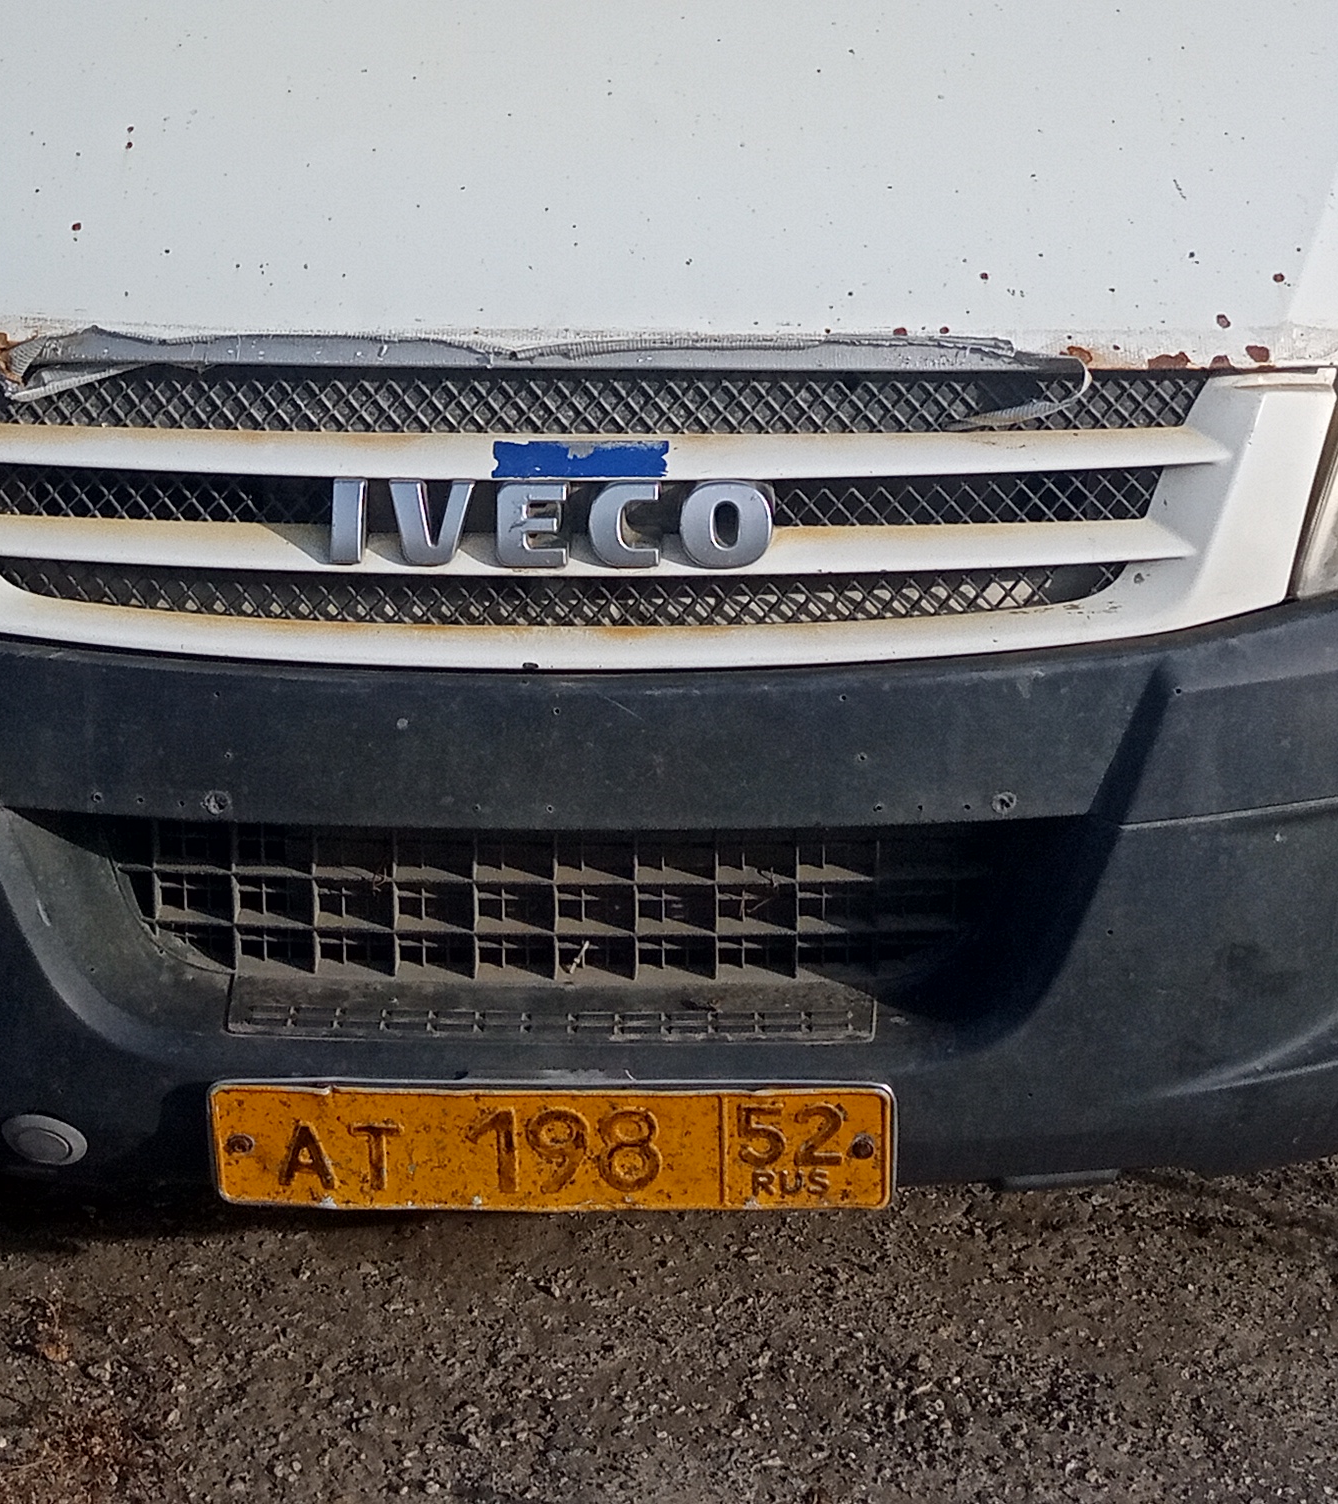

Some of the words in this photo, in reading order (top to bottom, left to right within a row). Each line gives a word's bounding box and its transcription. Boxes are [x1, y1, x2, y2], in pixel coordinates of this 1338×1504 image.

[330, 478, 774, 569] IVECO
[464, 1105, 662, 1193] 198
[736, 1102, 844, 1168] 52
[751, 1168, 831, 1196] RUS
